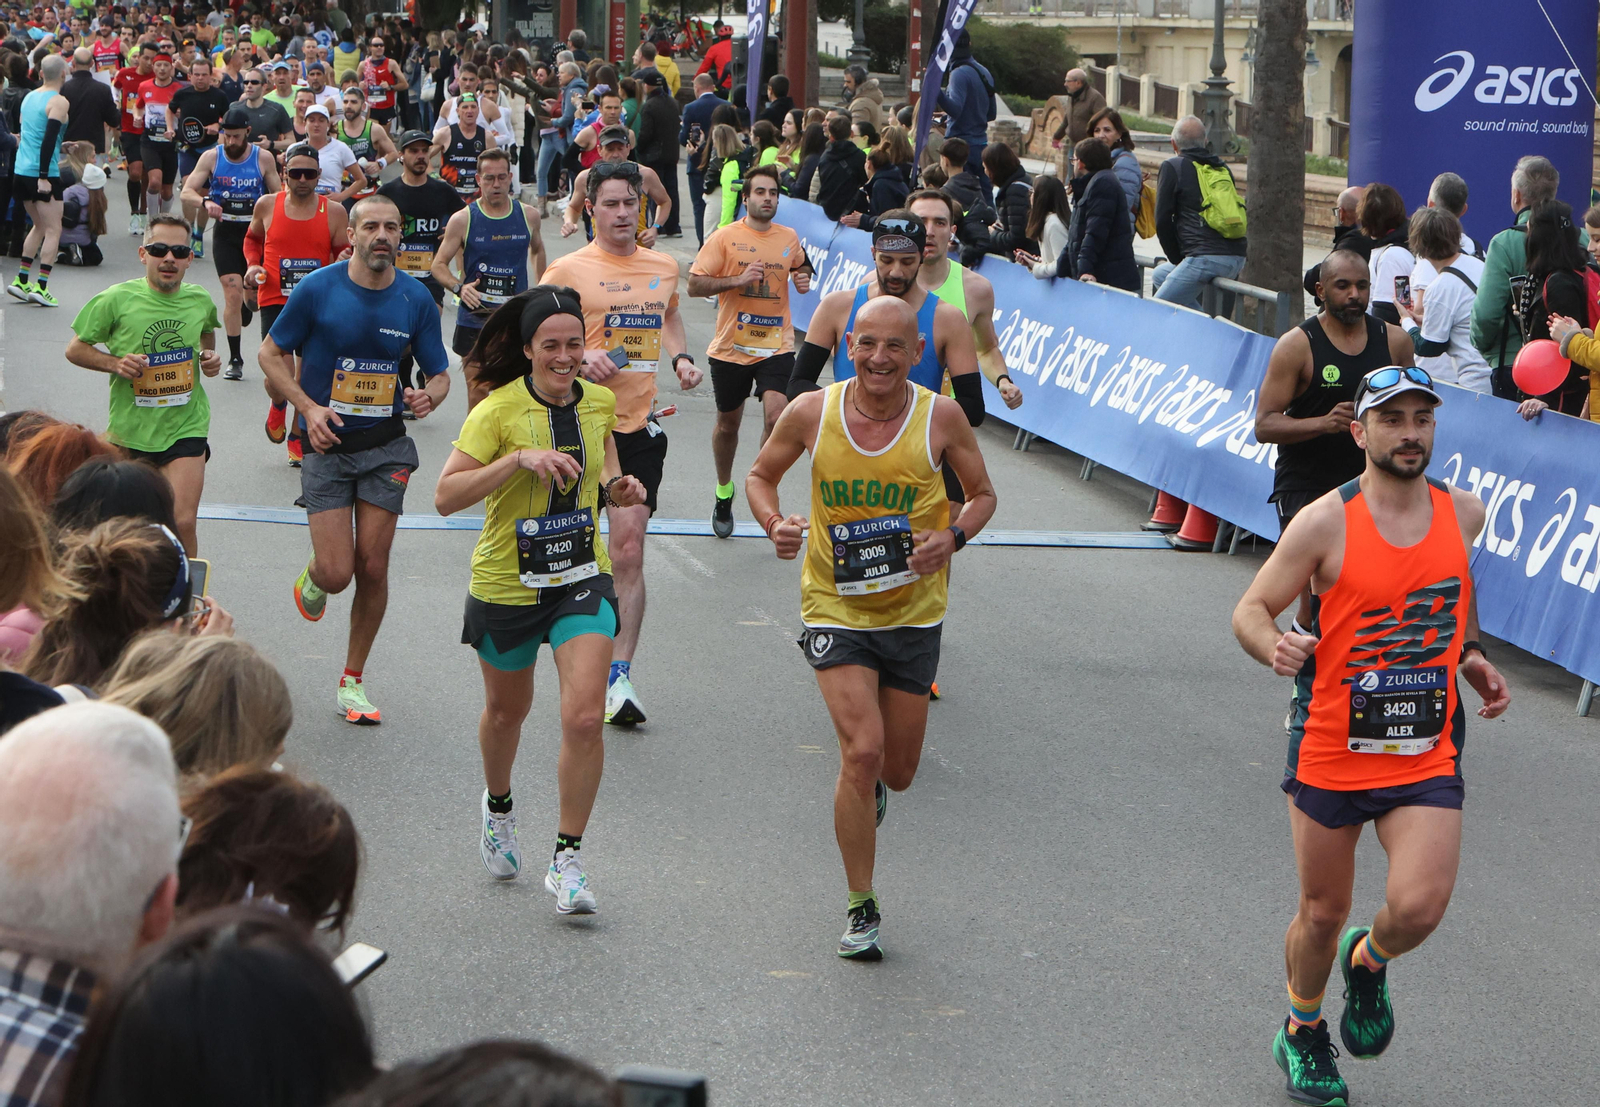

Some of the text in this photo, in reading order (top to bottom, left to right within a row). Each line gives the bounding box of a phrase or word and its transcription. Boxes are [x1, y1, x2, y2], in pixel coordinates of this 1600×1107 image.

[1474, 66, 1580, 106] asics
[1464, 118, 1589, 136] sound mind, sound body
[610, 303, 639, 312] Maratón
[624, 318, 656, 326] ZURICH
[623, 336, 642, 345] 4242
[154, 351, 187, 363] ZURICH
[359, 362, 392, 371] ZURICH
[154, 371, 176, 382] 6188
[1005, 318, 1232, 433] asics asics asics asics
[159, 383, 192, 394] MORCILLO
[356, 380, 376, 390] 4113
[820, 479, 919, 513] OREGON
[544, 513, 584, 530] ZURICH
[853, 520, 900, 535] ZURICH
[546, 540, 572, 555] 2420
[859, 545, 886, 561] 3009
[548, 559, 572, 572] TANIA
[863, 564, 890, 578] JULIO
[1385, 672, 1436, 686] ZURICH
[1384, 702, 1416, 716] 3420
[1386, 726, 1414, 737] ALEX
